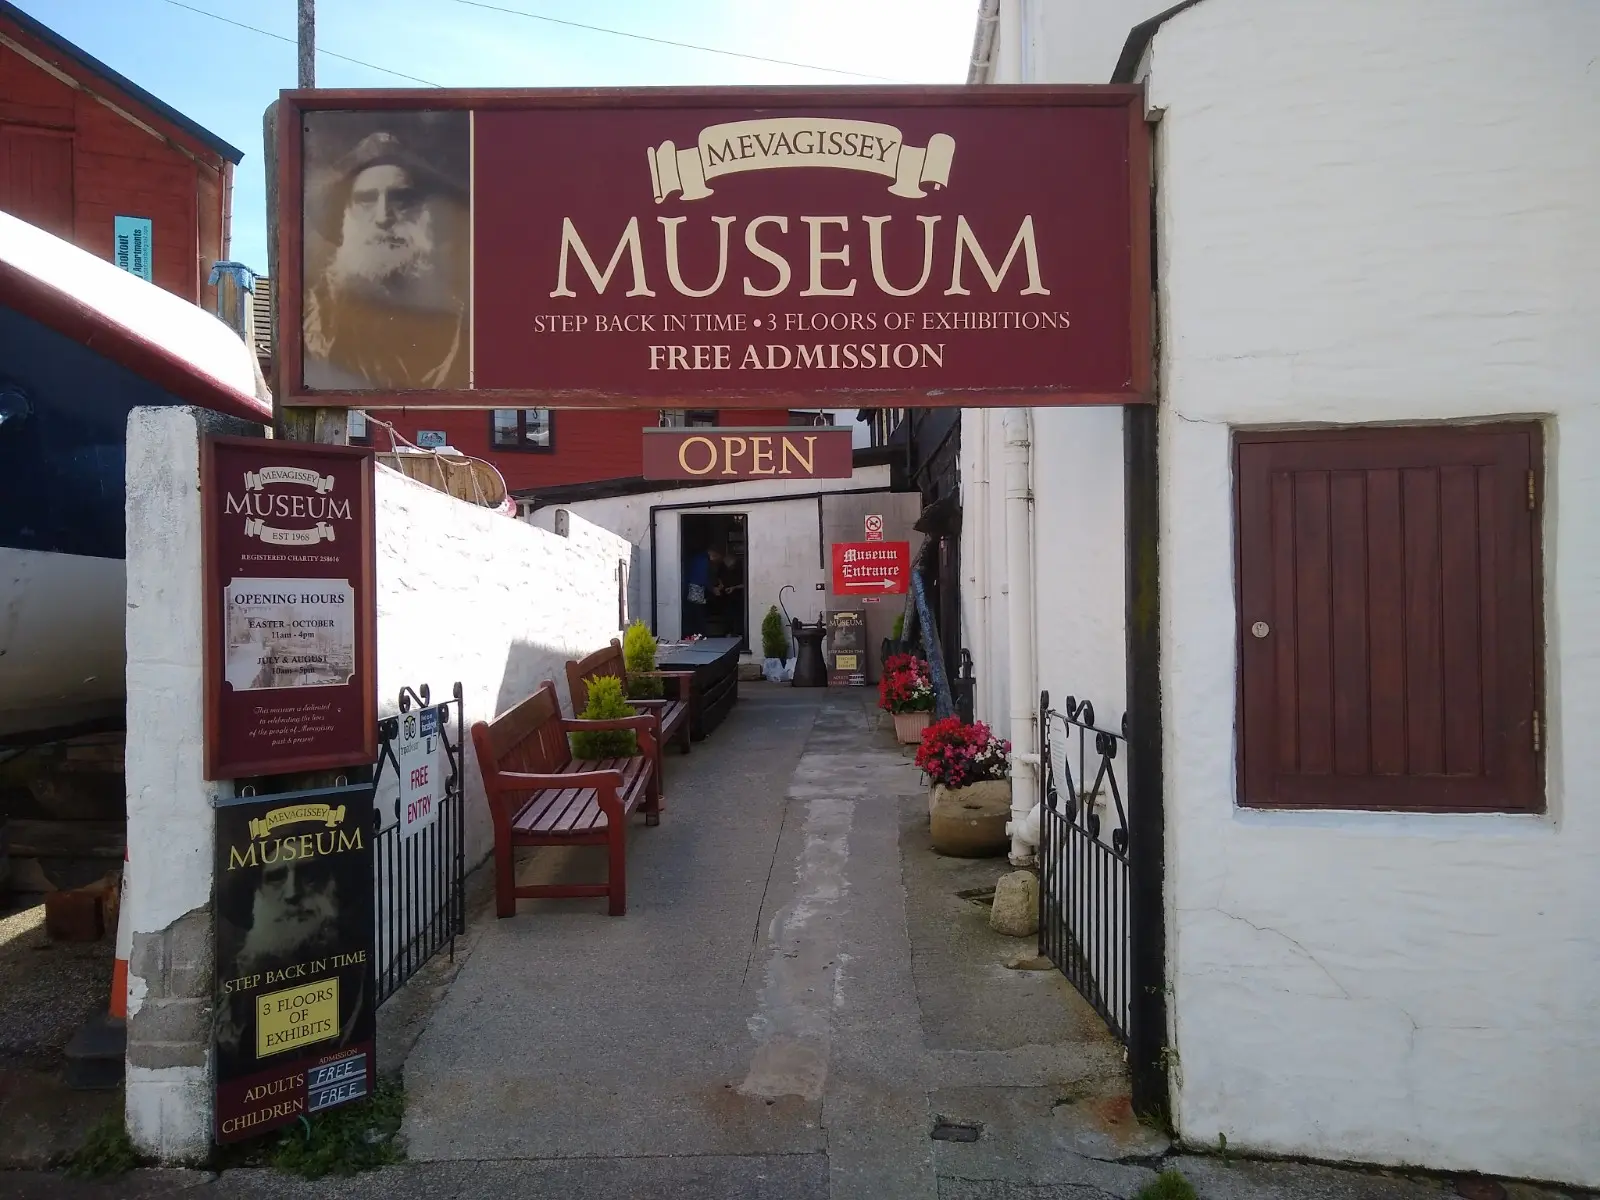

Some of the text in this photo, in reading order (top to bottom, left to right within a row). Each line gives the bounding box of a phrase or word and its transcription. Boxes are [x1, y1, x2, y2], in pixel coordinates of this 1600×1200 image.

[707, 130, 897, 167] MEVAGISSEY
[133, 229, 143, 272] Apartments
[549, 214, 1051, 298] MUSEUM
[534, 311, 1071, 333] STEP BACK IN TIME 3 FLOORS OF EXHIBITIONS
[648, 343, 946, 370] FREE ADMISSION
[678, 436, 817, 475] OPEN
[262, 470, 318, 483] MEVAGISSEY
[224, 492, 353, 520] MUSEUM
[272, 532, 290, 541] EST
[843, 549, 898, 562] Museum
[842, 565, 900, 578] Entrance
[234, 593, 345, 604] OPENING HOURS
[249, 620, 285, 629] EASTER
[292, 620, 335, 628] OCTOBER
[298, 631, 315, 640] 4pm
[257, 657, 280, 665] JULY
[291, 655, 328, 664] AUGUST
[410, 765, 429, 791] FREE
[268, 807, 328, 825] MEVAGISSEY
[407, 794, 432, 824] ENTRY
[227, 827, 364, 871] MUSEUM
[225, 950, 367, 994] STEP BACK IN TIME
[263, 988, 333, 1016] 3 FLOORS
[289, 1009, 309, 1024] OF
[266, 1018, 331, 1048] EXHIBITS
[319, 1048, 358, 1064] ADMISSION
[243, 1061, 354, 1104] ADULTS FREE
[221, 1082, 357, 1134] CHILDREN FREE
